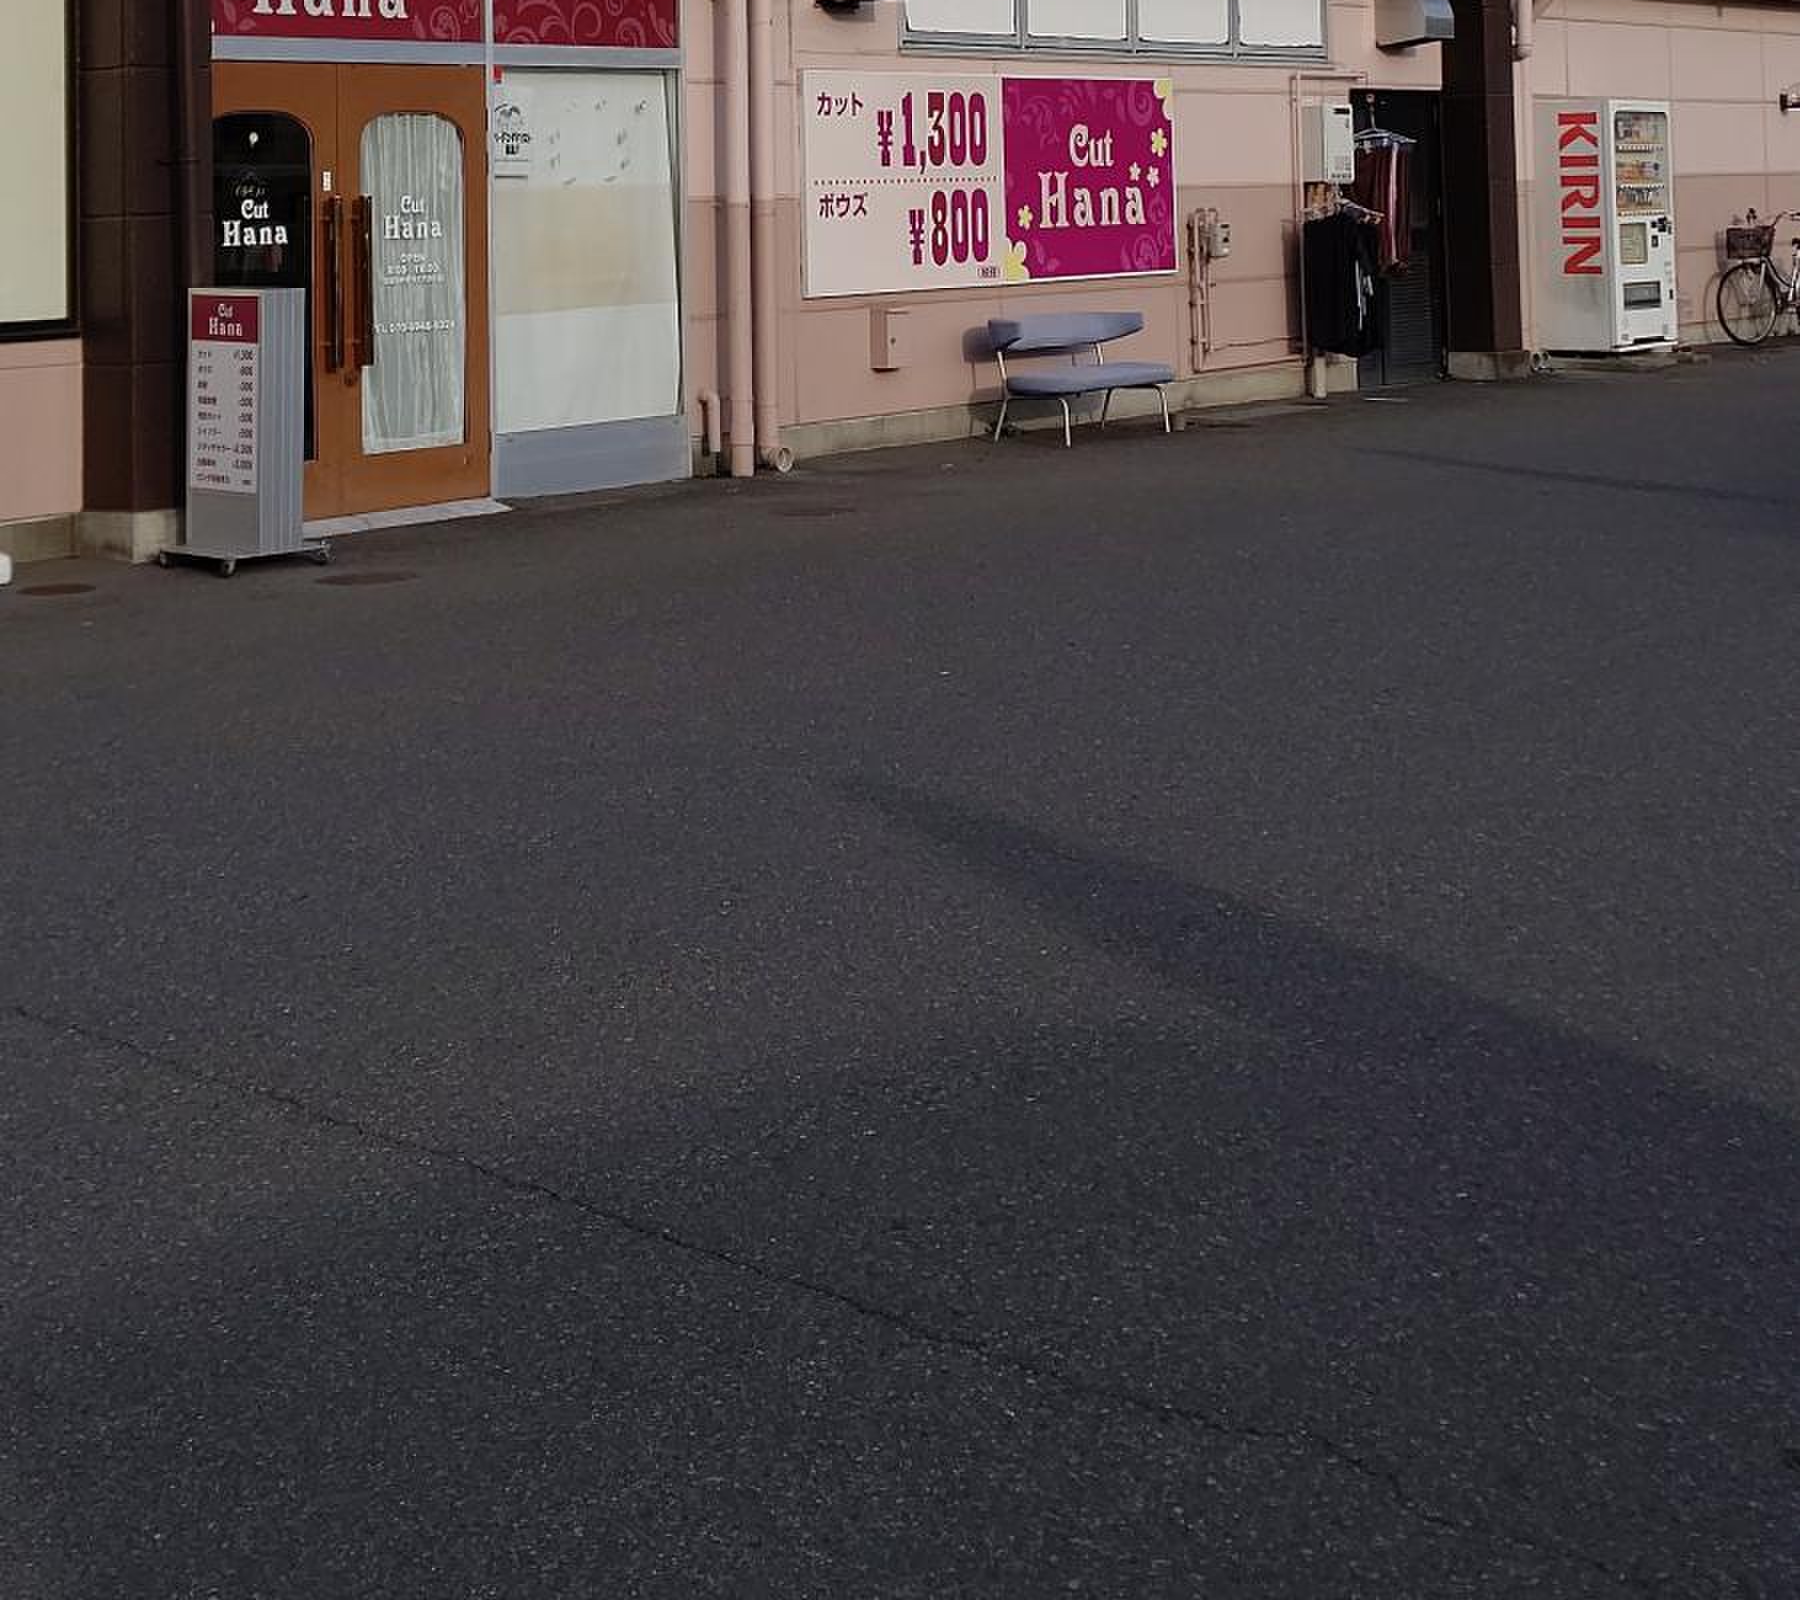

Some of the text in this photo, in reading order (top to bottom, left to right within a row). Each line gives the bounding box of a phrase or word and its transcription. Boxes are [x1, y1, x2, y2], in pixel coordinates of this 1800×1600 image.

[817, 91, 987, 174] カット ¥1,300
[1069, 123, 1114, 167] Cut
[241, 199, 269, 219] Cut
[1038, 171, 1146, 228] Hana
[1557, 111, 1603, 274] KIRIN
[222, 220, 288, 246] Hana
[384, 214, 442, 239] Hana
[819, 188, 989, 266] ボウズ ¥800
[209, 317, 242, 337] Hana
